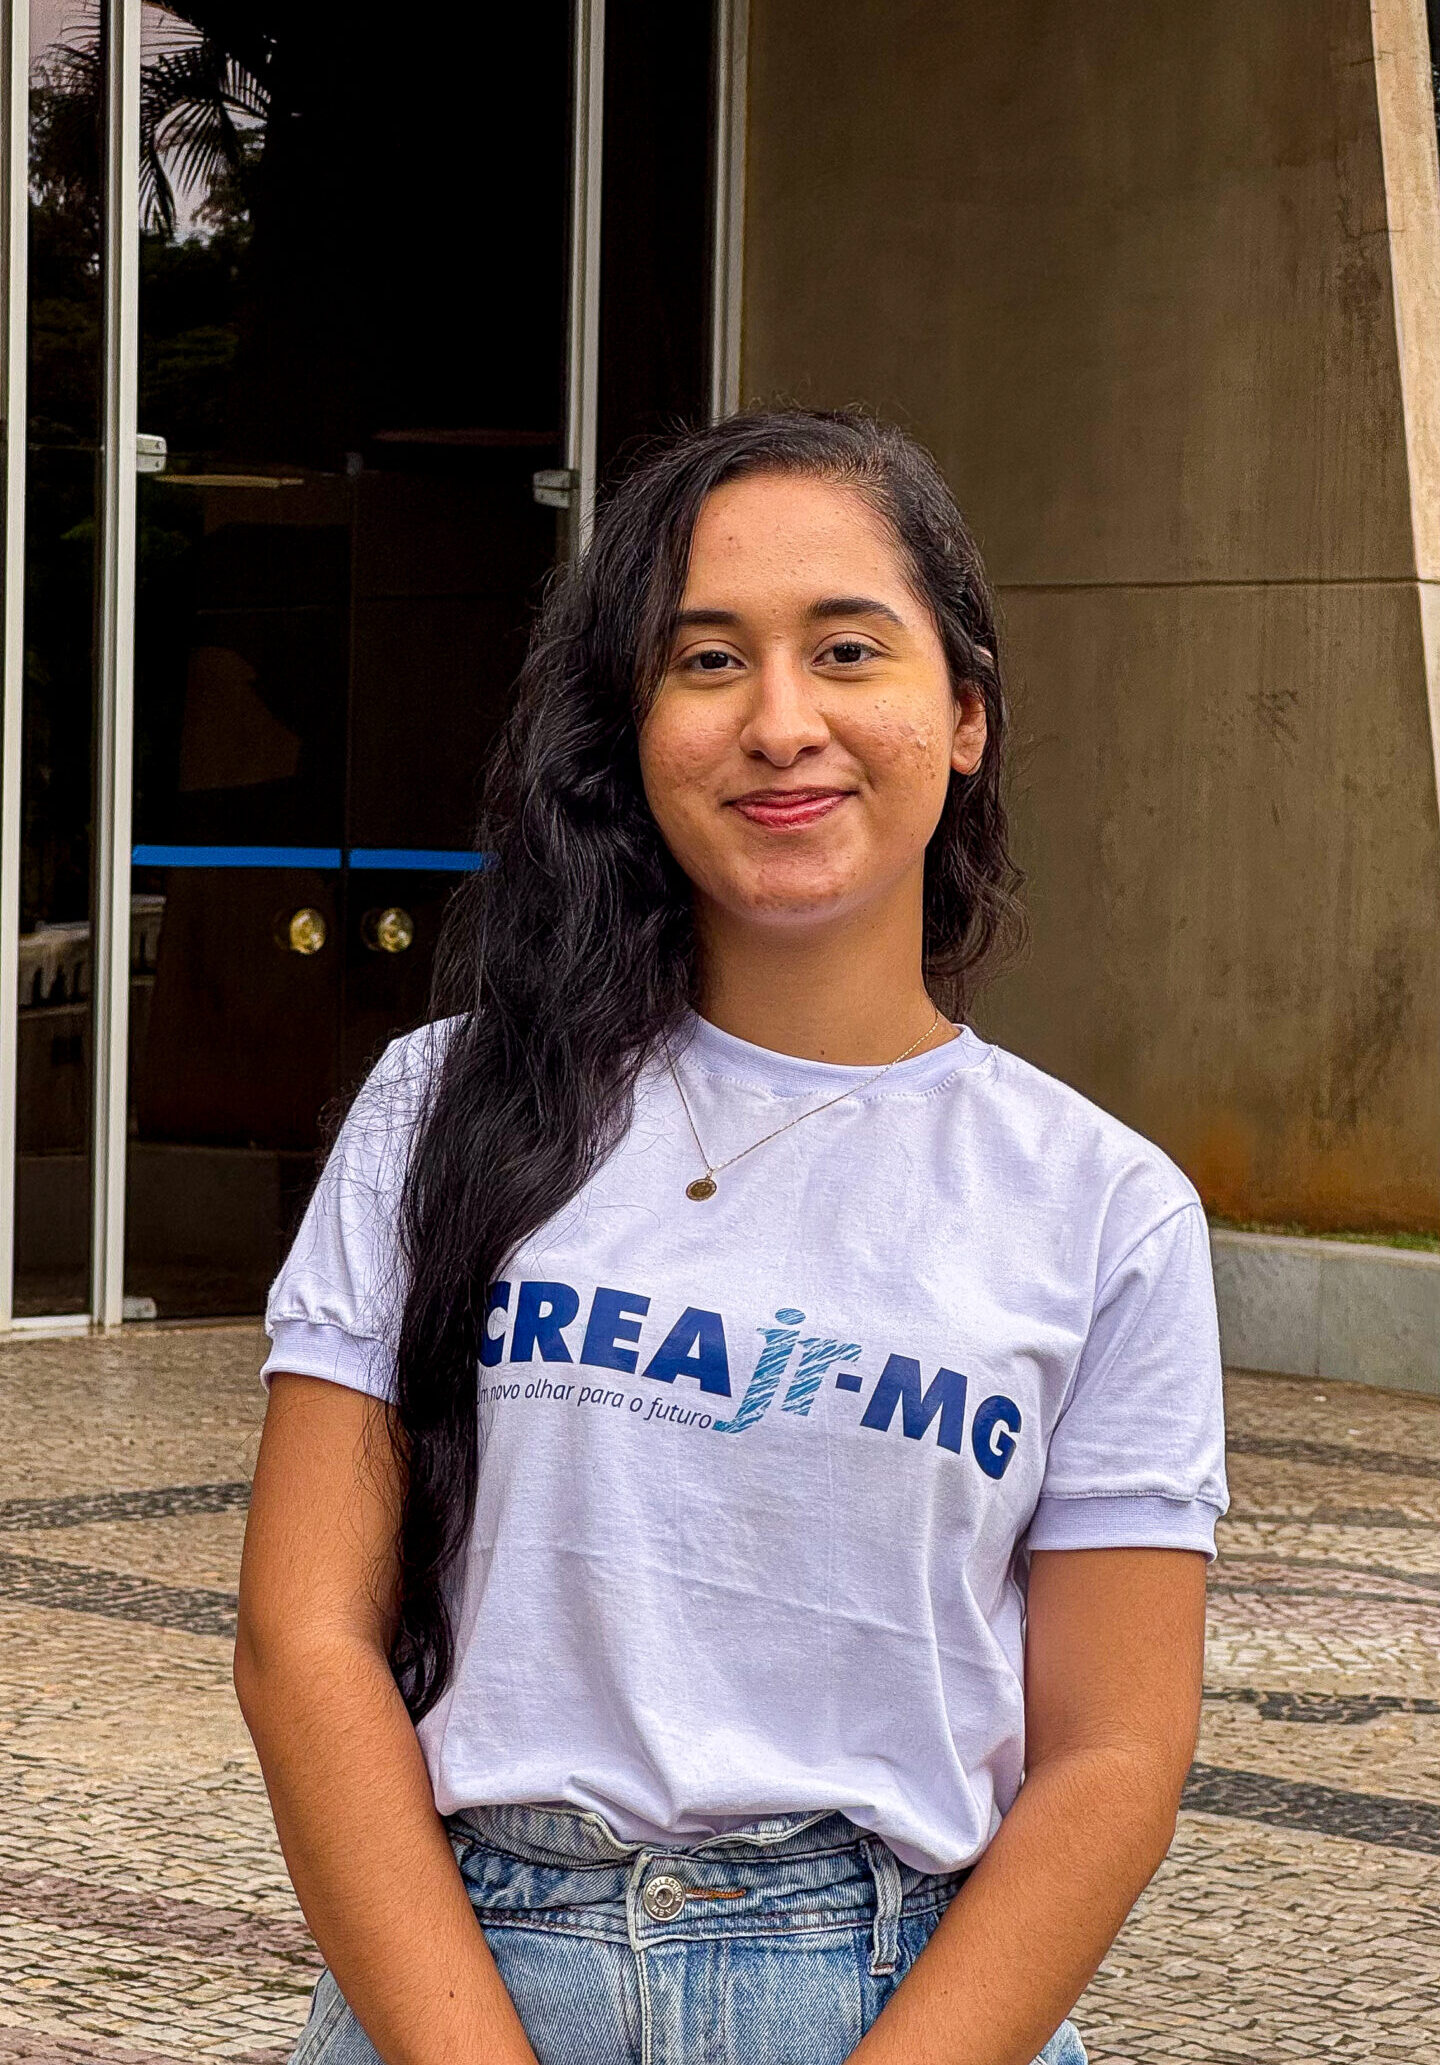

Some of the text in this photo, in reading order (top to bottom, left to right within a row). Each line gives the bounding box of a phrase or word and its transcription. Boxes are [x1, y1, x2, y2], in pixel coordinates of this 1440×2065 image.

[490, 1383, 520, 1402] novo
[524, 1378, 575, 1400] olhar
[576, 1386, 625, 1408] para
[629, 1397, 643, 1412] o
[643, 1397, 712, 1429] futuro
